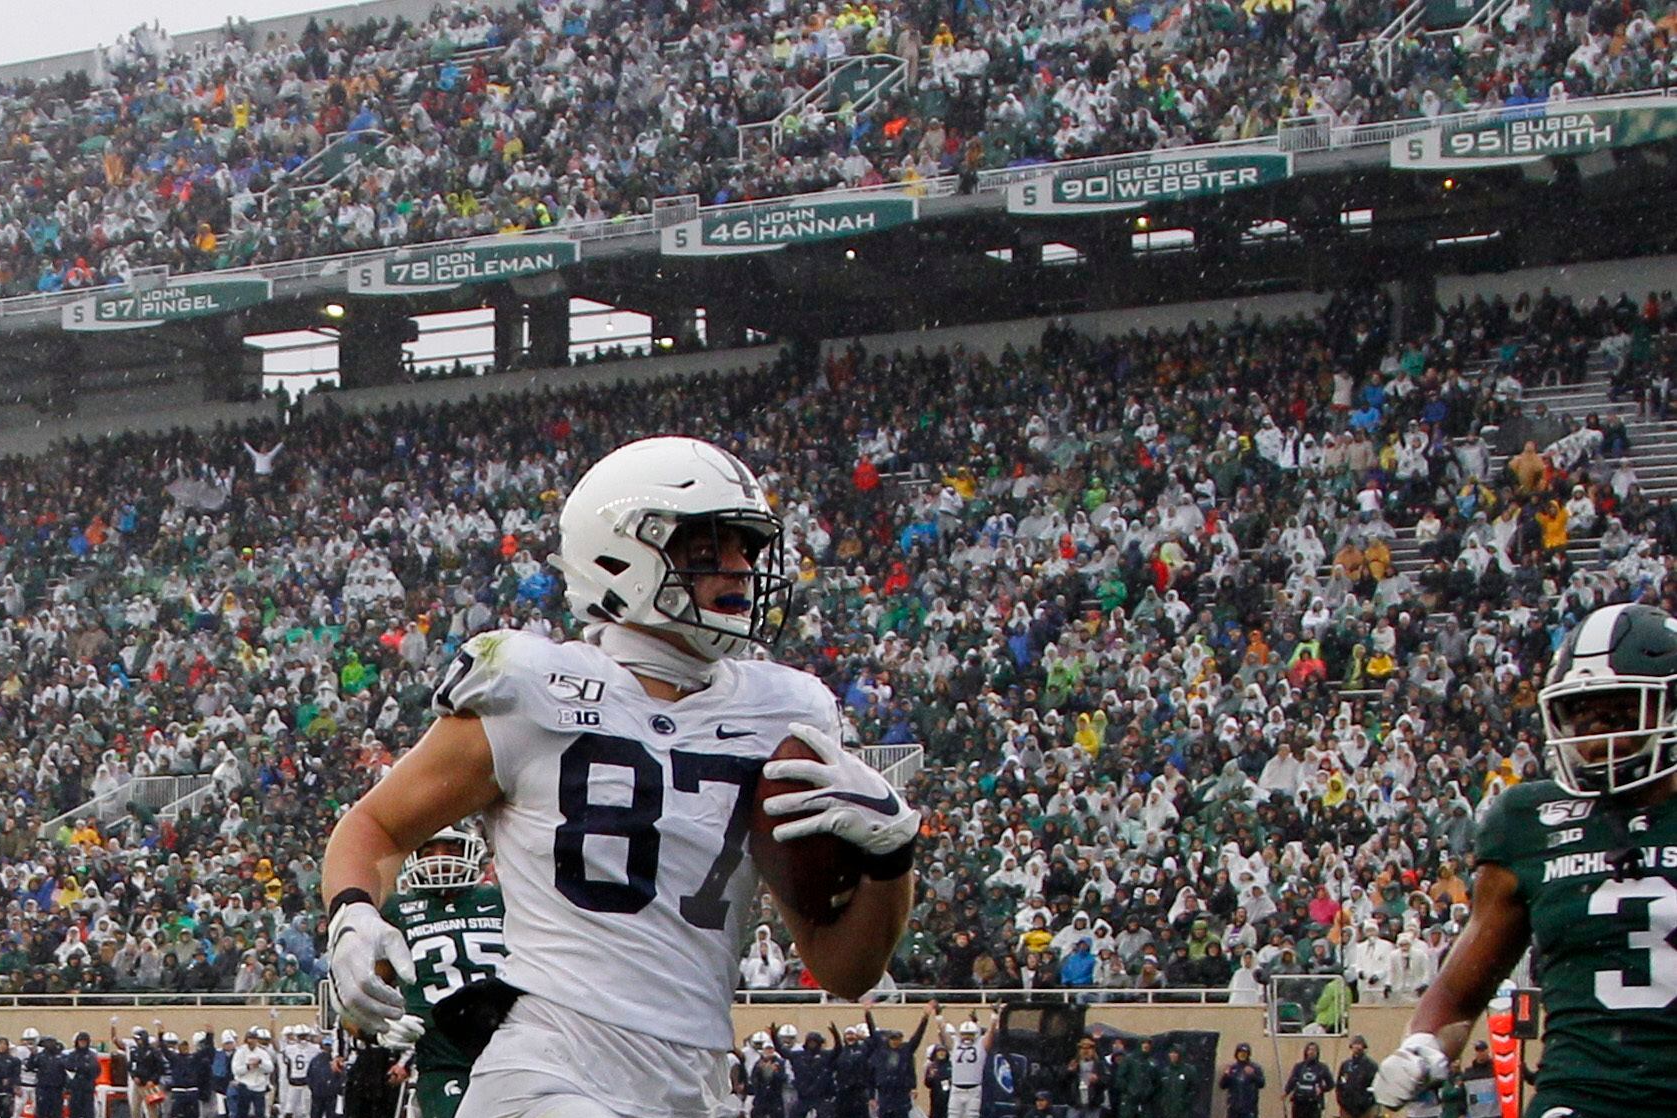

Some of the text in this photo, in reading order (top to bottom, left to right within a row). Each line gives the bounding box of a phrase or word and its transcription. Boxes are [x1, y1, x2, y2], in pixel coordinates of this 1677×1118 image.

[1512, 114, 1595, 134] BUBBA
[1450, 130, 1500, 153] 95
[1512, 125, 1612, 152] SMITH
[1117, 160, 1208, 180] GEORGE
[1062, 177, 1108, 199] 90
[1117, 167, 1259, 198] WEBSTER
[759, 208, 815, 225] JOHN
[759, 213, 875, 240] HANNAH
[710, 222, 752, 241] 46
[436, 252, 476, 266] DON
[436, 254, 554, 281] COLEMAN
[391, 262, 430, 282] 78
[141, 295, 220, 316] PINGEL
[142, 288, 186, 301] JOHN
[101, 300, 135, 318] 37
[546, 672, 605, 703] 150
[1537, 800, 1594, 825] 150
[554, 733, 771, 930] 87
[1542, 847, 1655, 882] MICHIN
[406, 918, 466, 941] MICHIGAN
[467, 917, 502, 930] STATE
[411, 931, 504, 1005] 35
[295, 1054, 305, 1070] 6
[956, 1047, 977, 1063] 73
